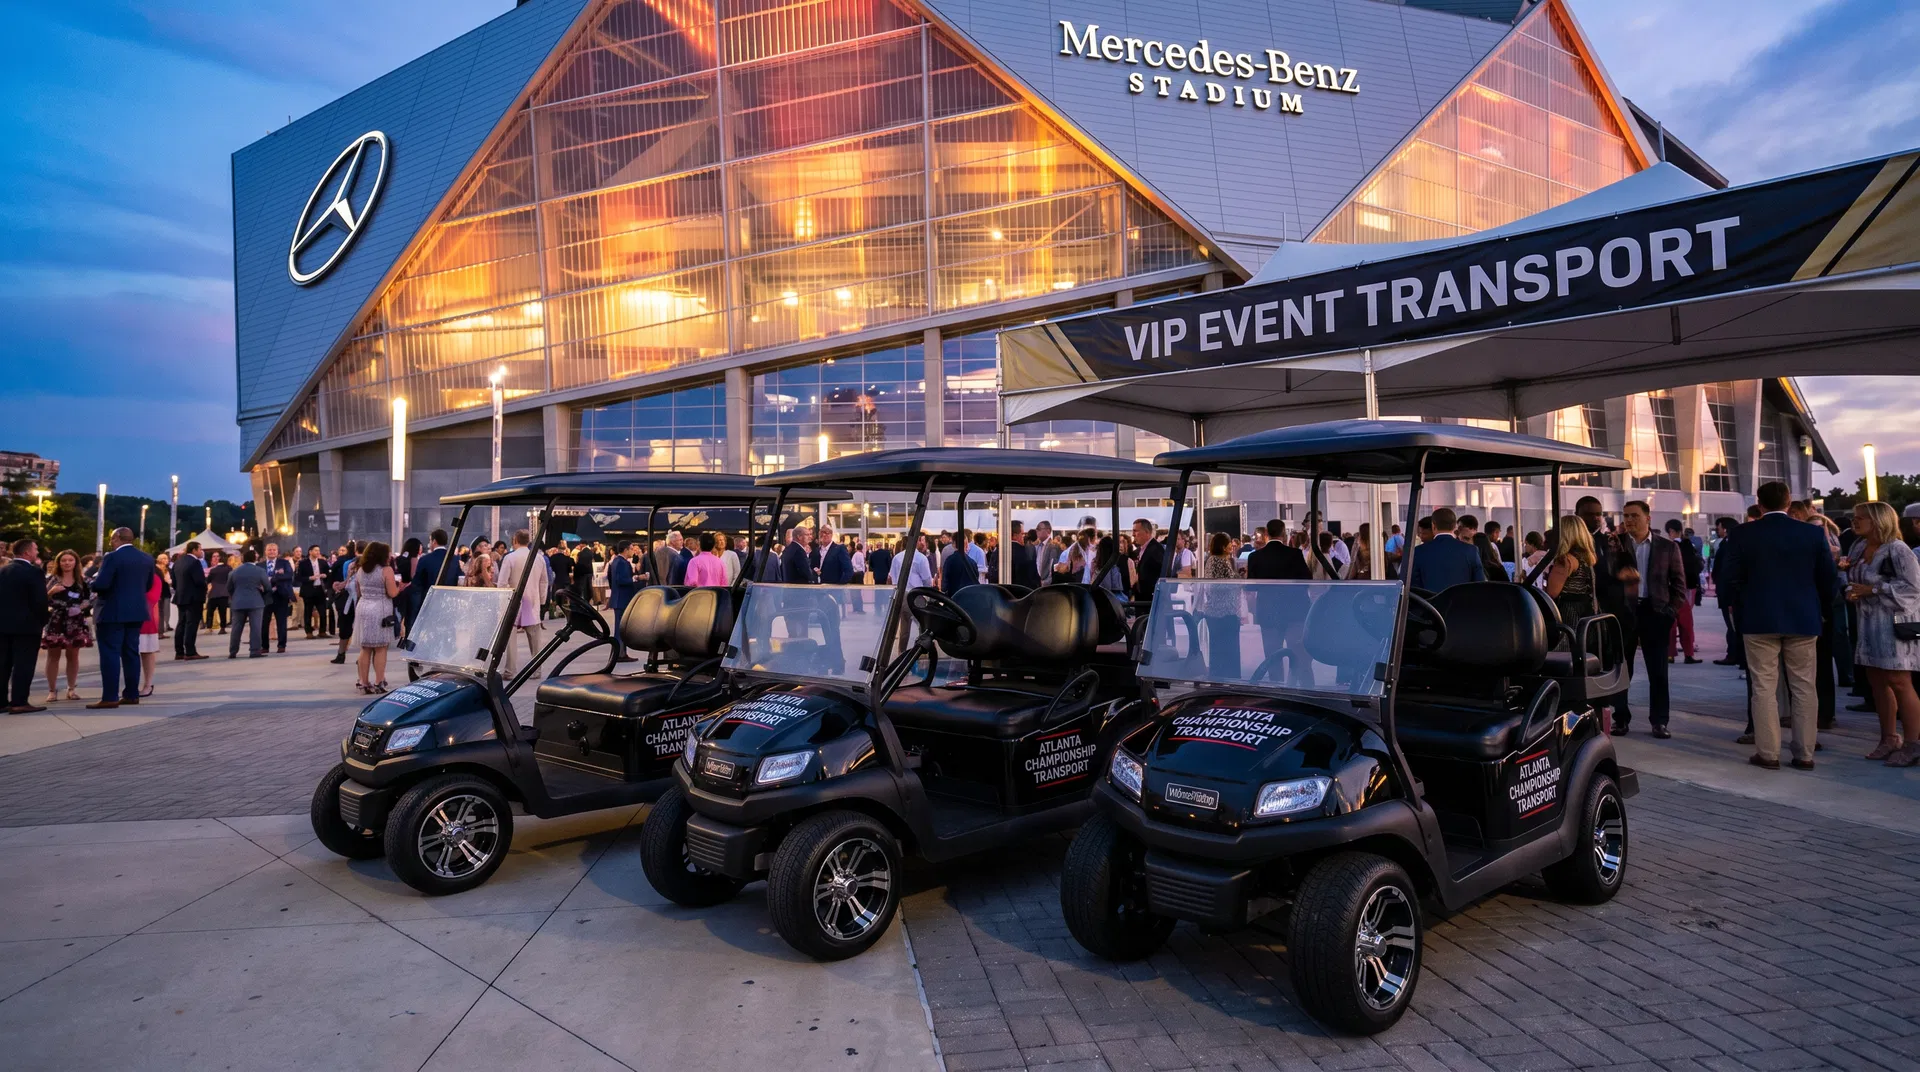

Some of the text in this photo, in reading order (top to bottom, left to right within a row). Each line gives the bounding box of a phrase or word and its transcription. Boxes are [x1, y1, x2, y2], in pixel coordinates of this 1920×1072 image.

[1059, 20, 1361, 94] Mercedes-Benz
[1129, 72, 1304, 113] STADIUM
[1124, 216, 1741, 361] VIP EVENT TRANSPORT
[662, 714, 704, 731] ATLANT
[1172, 716, 1292, 738] CHAMPIONSHIP
[1200, 707, 1275, 723] ATLANTA
[1039, 734, 1082, 755] ATLANTA
[1174, 726, 1268, 746] TRANSPORT
[1025, 744, 1097, 771] CHAMPIONSHIP
[1519, 756, 1551, 780] ATLANTA
[1033, 759, 1089, 784] TRANSPORT
[1509, 767, 1561, 800] CHAMPIONSHIP
[1516, 785, 1557, 813] TRANSPORT
